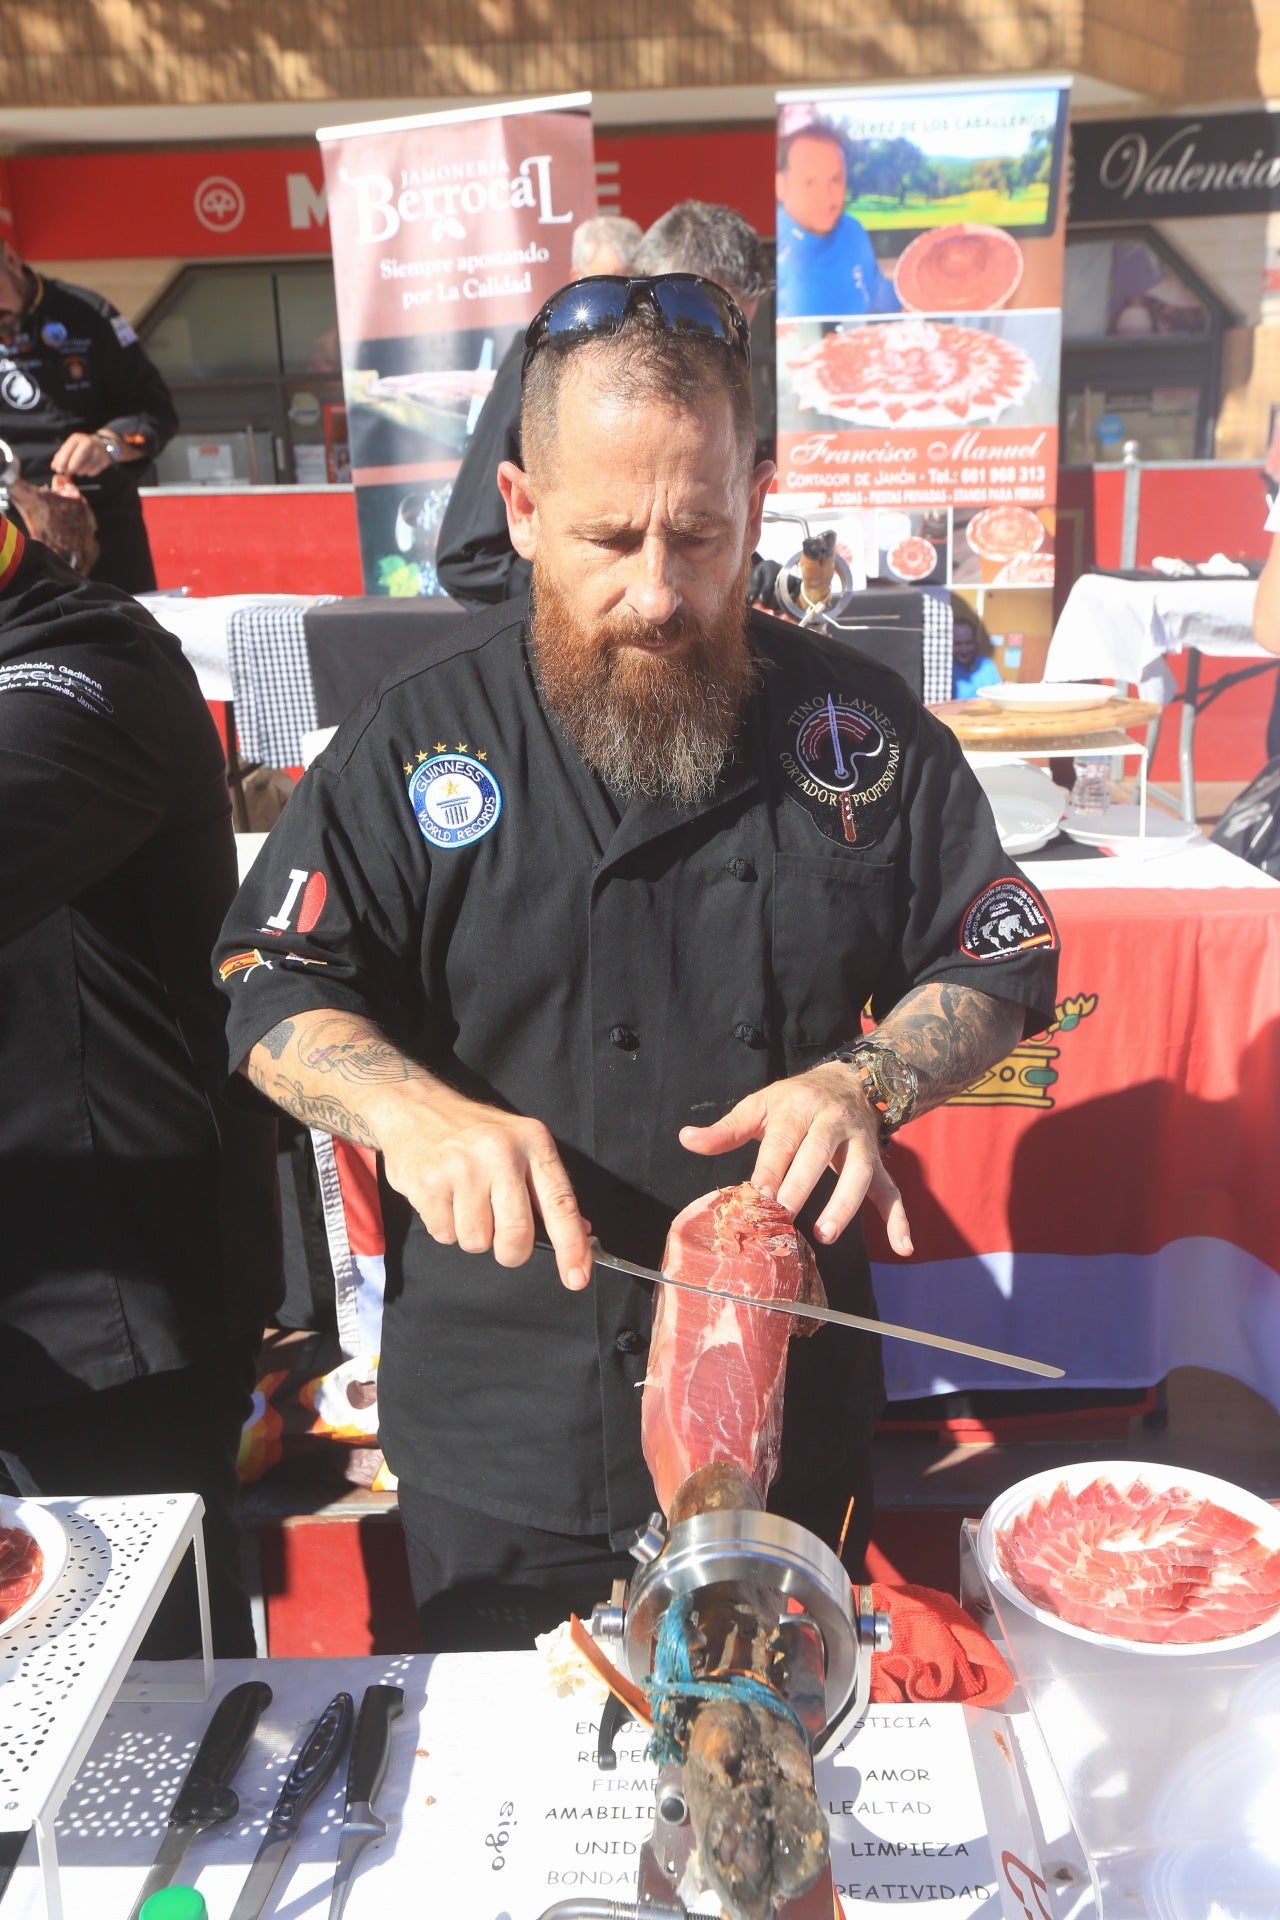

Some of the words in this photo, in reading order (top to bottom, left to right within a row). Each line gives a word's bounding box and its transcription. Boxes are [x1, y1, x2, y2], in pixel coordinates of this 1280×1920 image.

[1100, 123, 1280, 199] Valencia
[380, 258, 453, 279] Siempre
[457, 241, 549, 273] apostando
[402, 291, 434, 310] por
[437, 282, 460, 302] La
[463, 272, 532, 299] Calidad
[790, 434, 919, 466] Francisco
[927, 431, 1047, 462] Manuel
[854, 471, 871, 486] DE
[1019, 465, 1045, 483] 313
[59, 665, 103, 691] Gaditana
[788, 696, 825, 727] TINO
[838, 693, 897, 740] LAYNEZ
[416, 761, 484, 793] GUINNESS
[780, 752, 838, 806] CORTADOR
[850, 741, 900, 807] PROFESIONAL
[418, 809, 451, 841] WORLD
[457, 796, 495, 841] RECORDS
[266, 868, 309, 931] I
[865, 1769, 930, 1782] AMOR
[829, 1800, 932, 1815] LEALTAD
[851, 1842, 969, 1857] LIMPIEZA
[834, 1883, 991, 1901] REATIVIDAD
